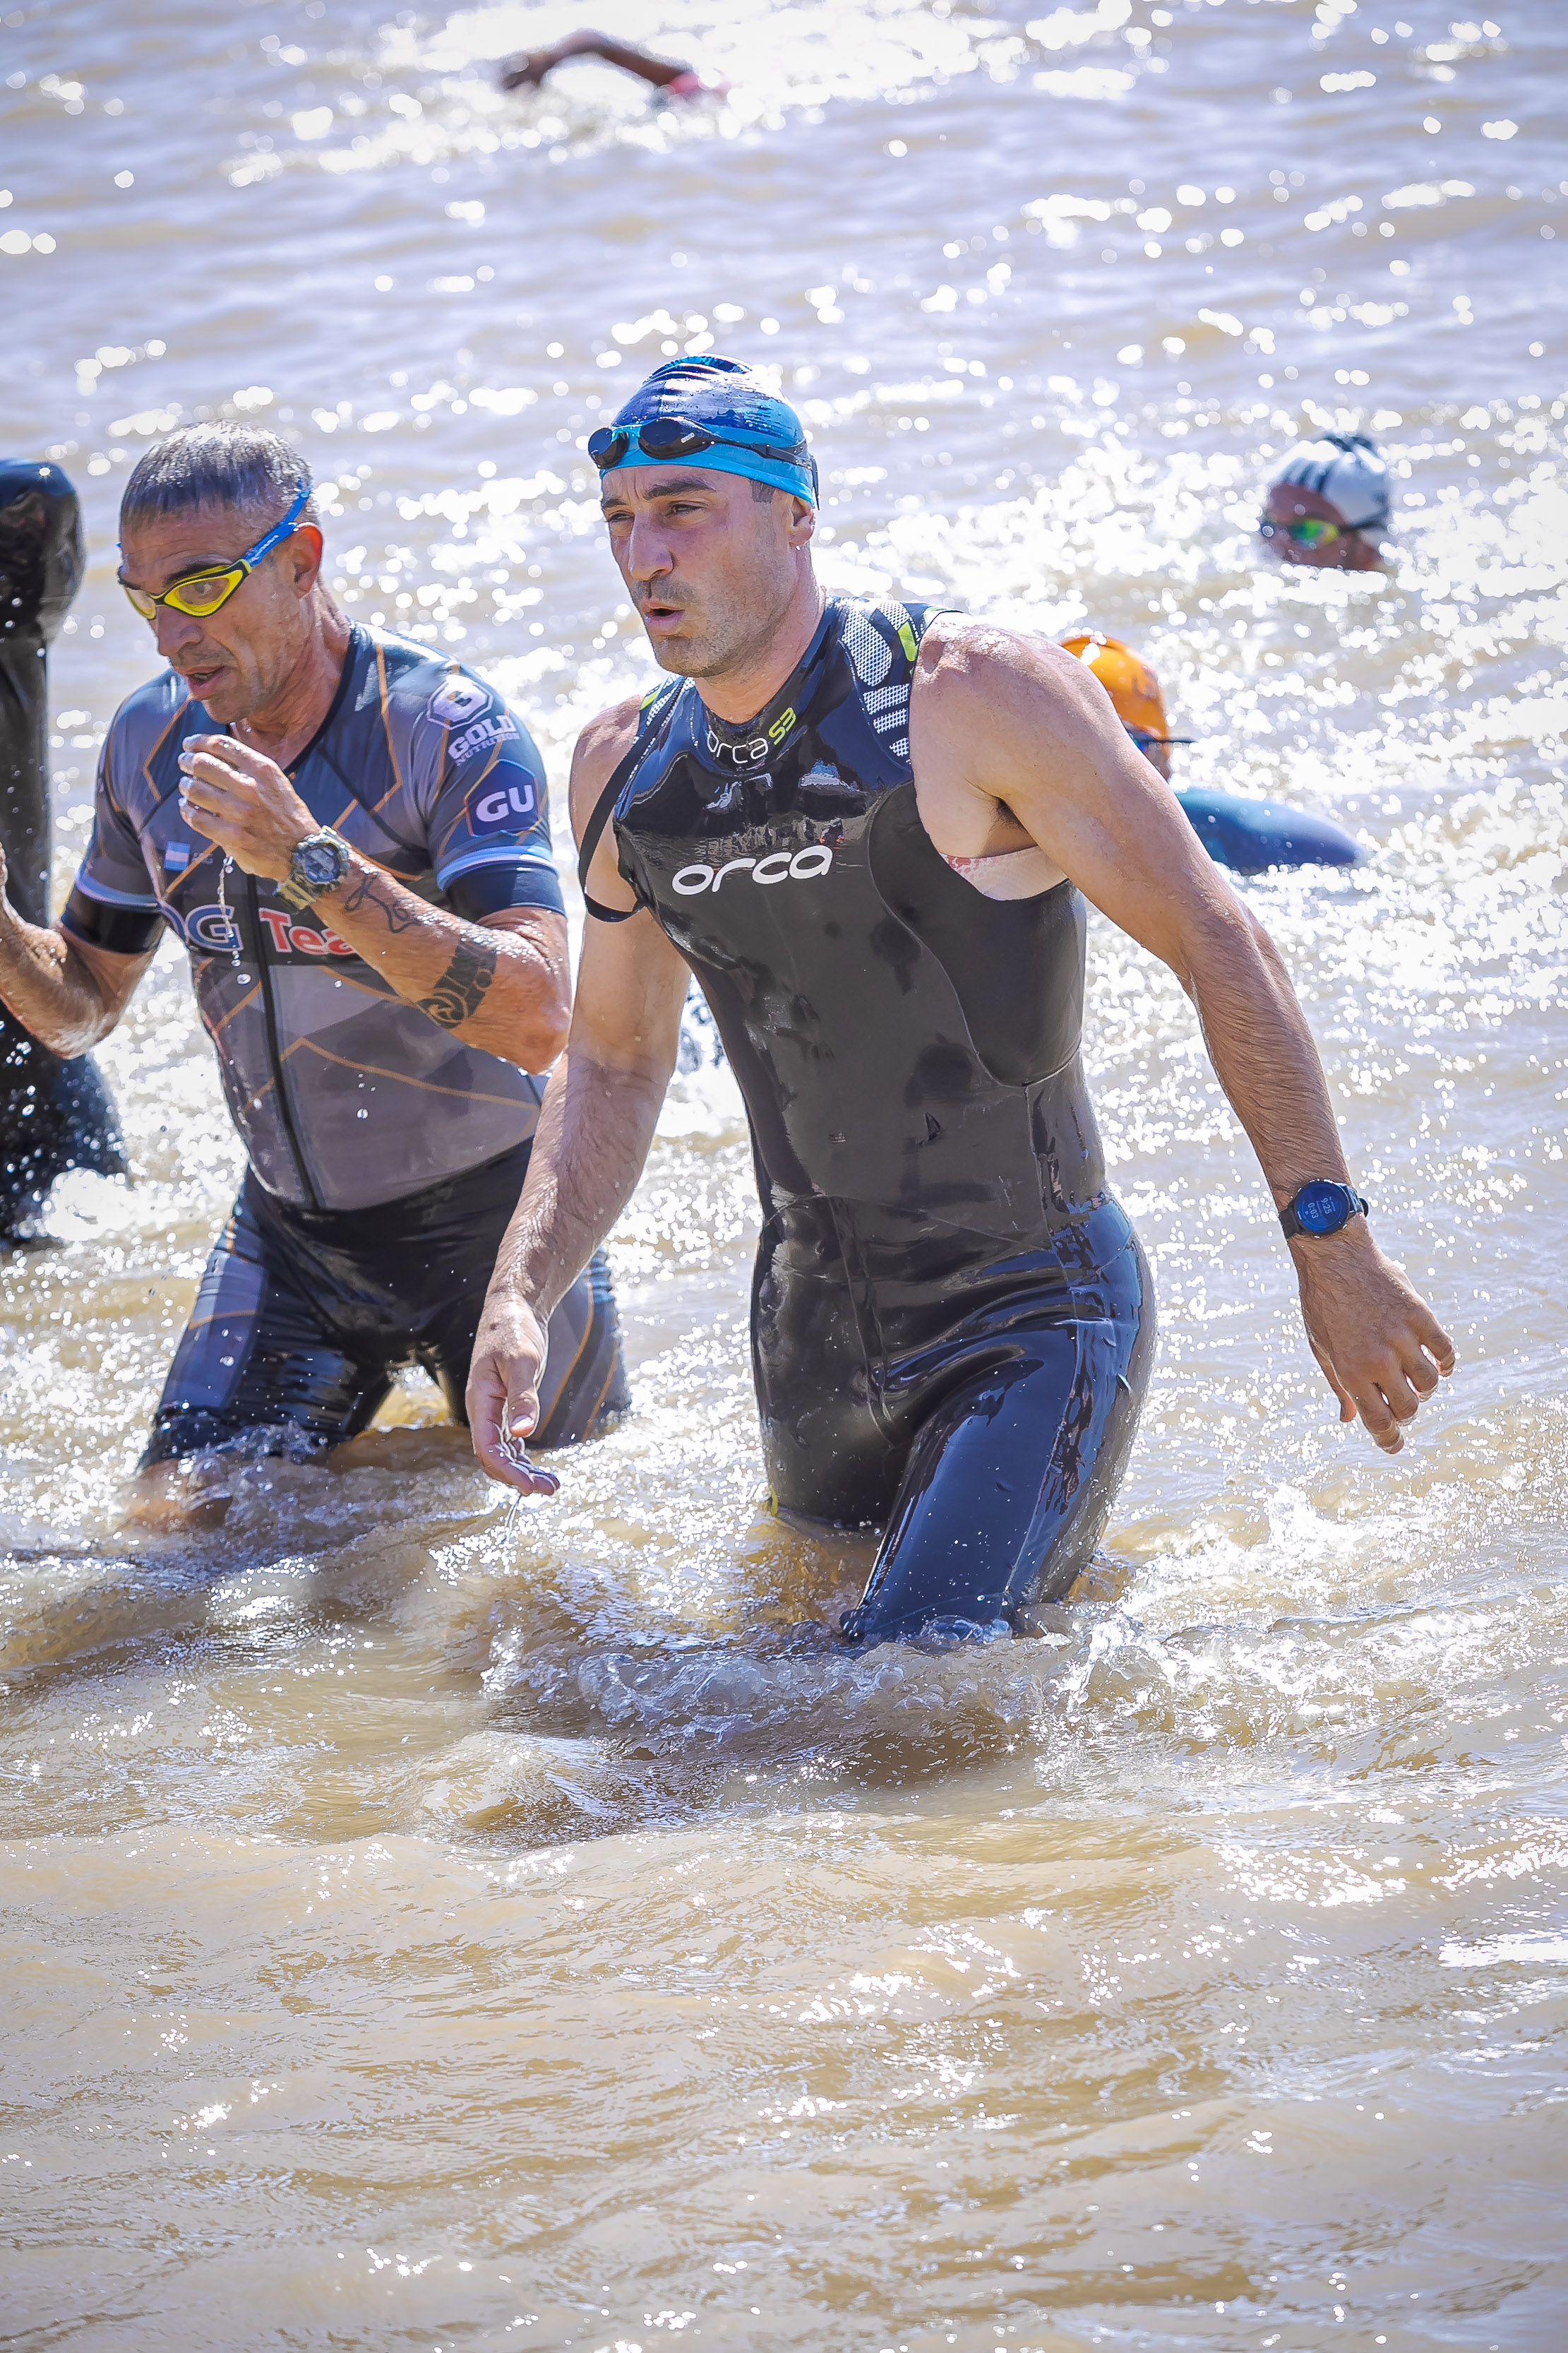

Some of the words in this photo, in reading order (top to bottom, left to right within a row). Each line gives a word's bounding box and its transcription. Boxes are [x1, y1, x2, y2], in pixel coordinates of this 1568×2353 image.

[448, 715, 517, 760] GOLD
[707, 729, 769, 763] orca
[768, 707, 796, 746] S3
[476, 785, 534, 822] GU
[672, 845, 832, 895] orca
